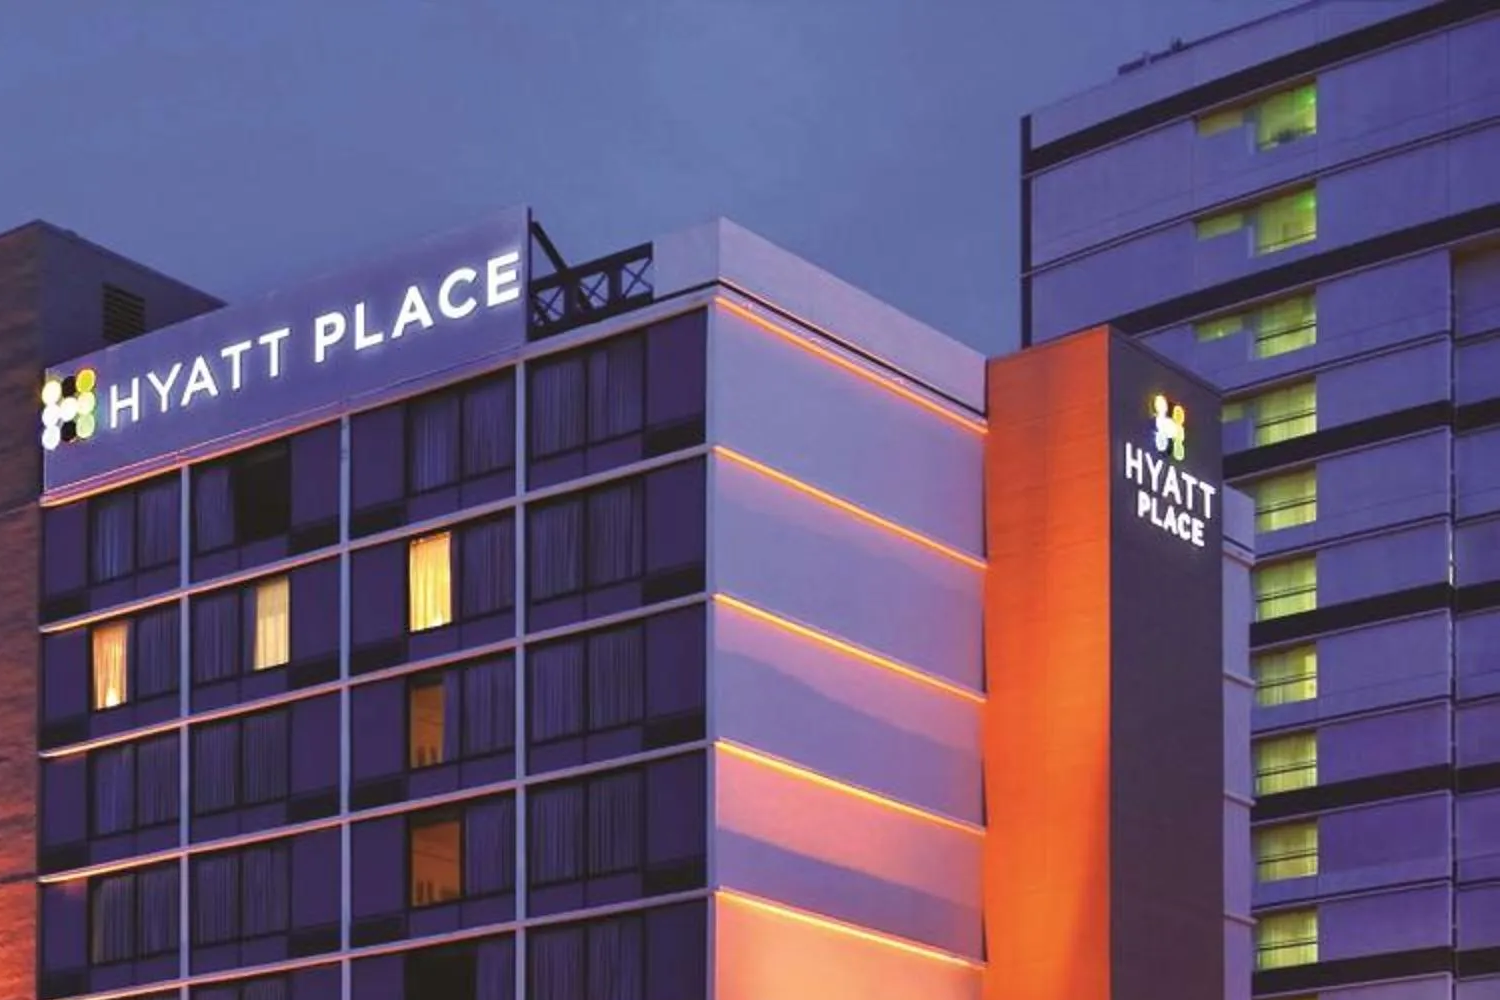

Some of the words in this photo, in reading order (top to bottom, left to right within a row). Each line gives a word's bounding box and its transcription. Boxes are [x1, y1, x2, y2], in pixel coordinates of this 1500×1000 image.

[108, 327, 291, 429] HYATT
[313, 250, 522, 363] PLACE
[1125, 442, 1217, 519] HYATT
[1137, 490, 1205, 547] PLACE
